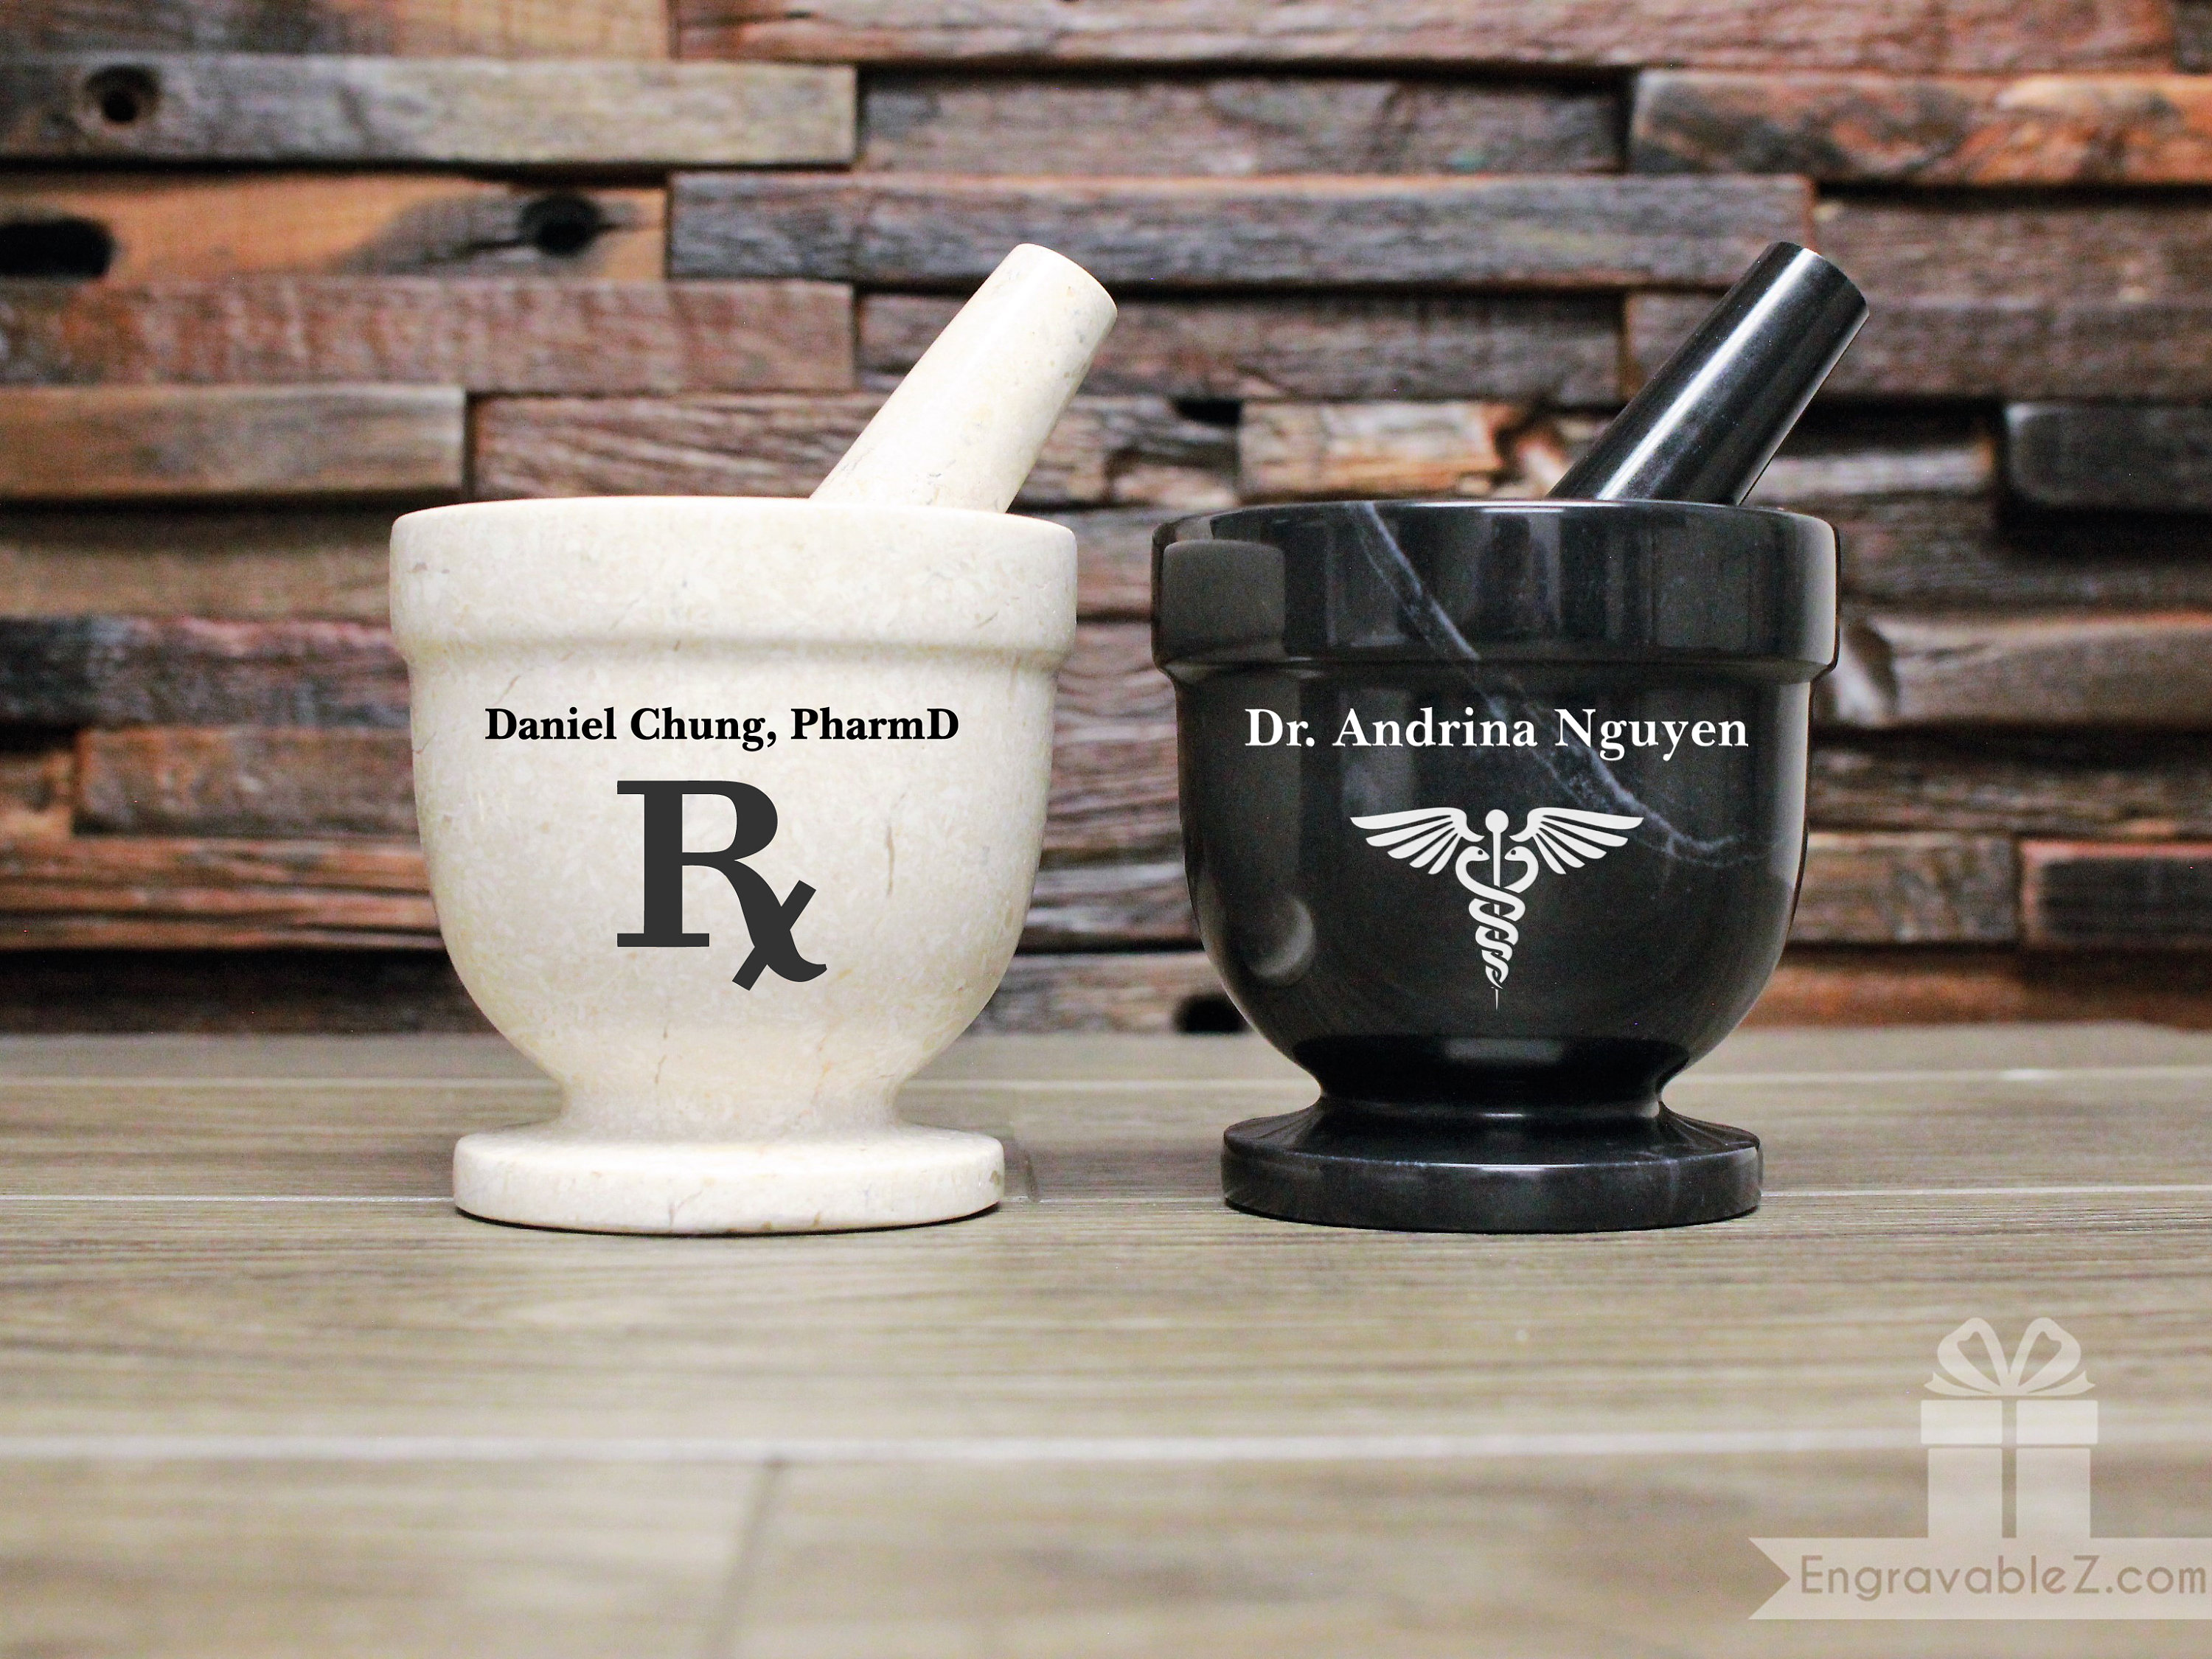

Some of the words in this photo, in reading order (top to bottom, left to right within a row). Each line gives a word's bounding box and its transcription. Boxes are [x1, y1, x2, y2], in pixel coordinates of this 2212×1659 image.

[484, 706, 617, 740] Daniel
[630, 706, 776, 752] Chung,
[790, 706, 959, 740] PharmD
[1245, 708, 1315, 748] Dr.
[1332, 706, 1538, 748] Andrina
[1554, 708, 1750, 761] Nguyen
